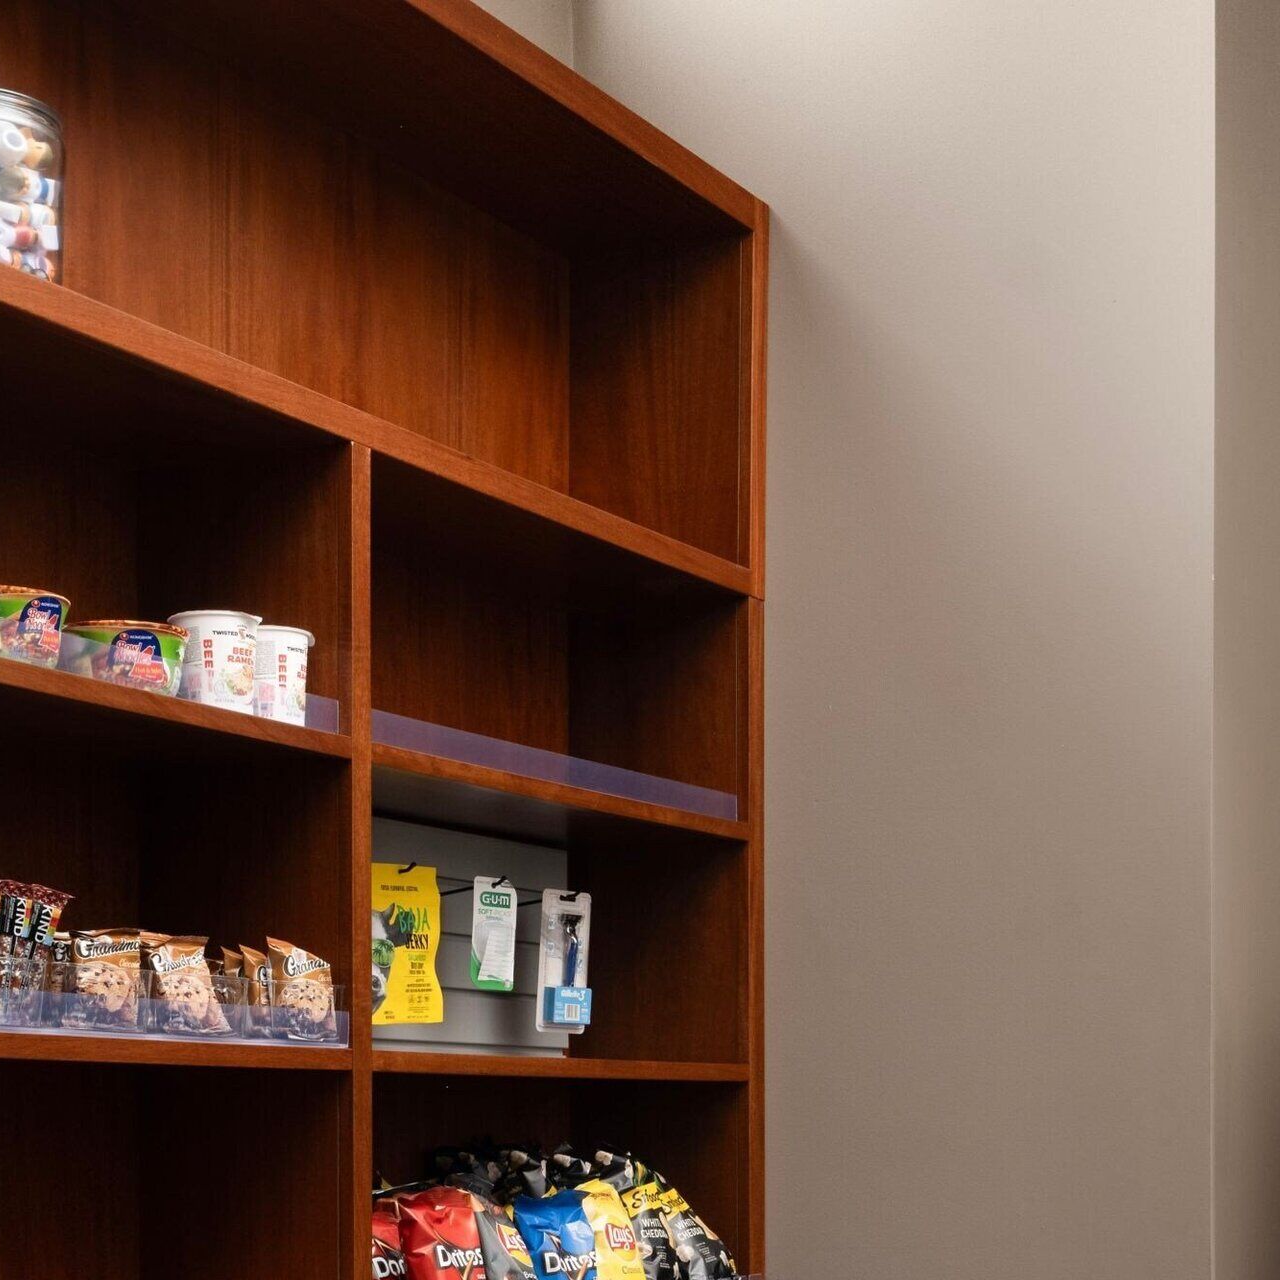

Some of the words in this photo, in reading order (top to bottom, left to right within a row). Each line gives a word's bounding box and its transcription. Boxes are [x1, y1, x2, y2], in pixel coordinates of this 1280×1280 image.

[13, 897, 27, 937] KIND
[34, 905, 53, 944] KIND
[396, 904, 431, 934] BAJA
[405, 933, 429, 950] JERKY
